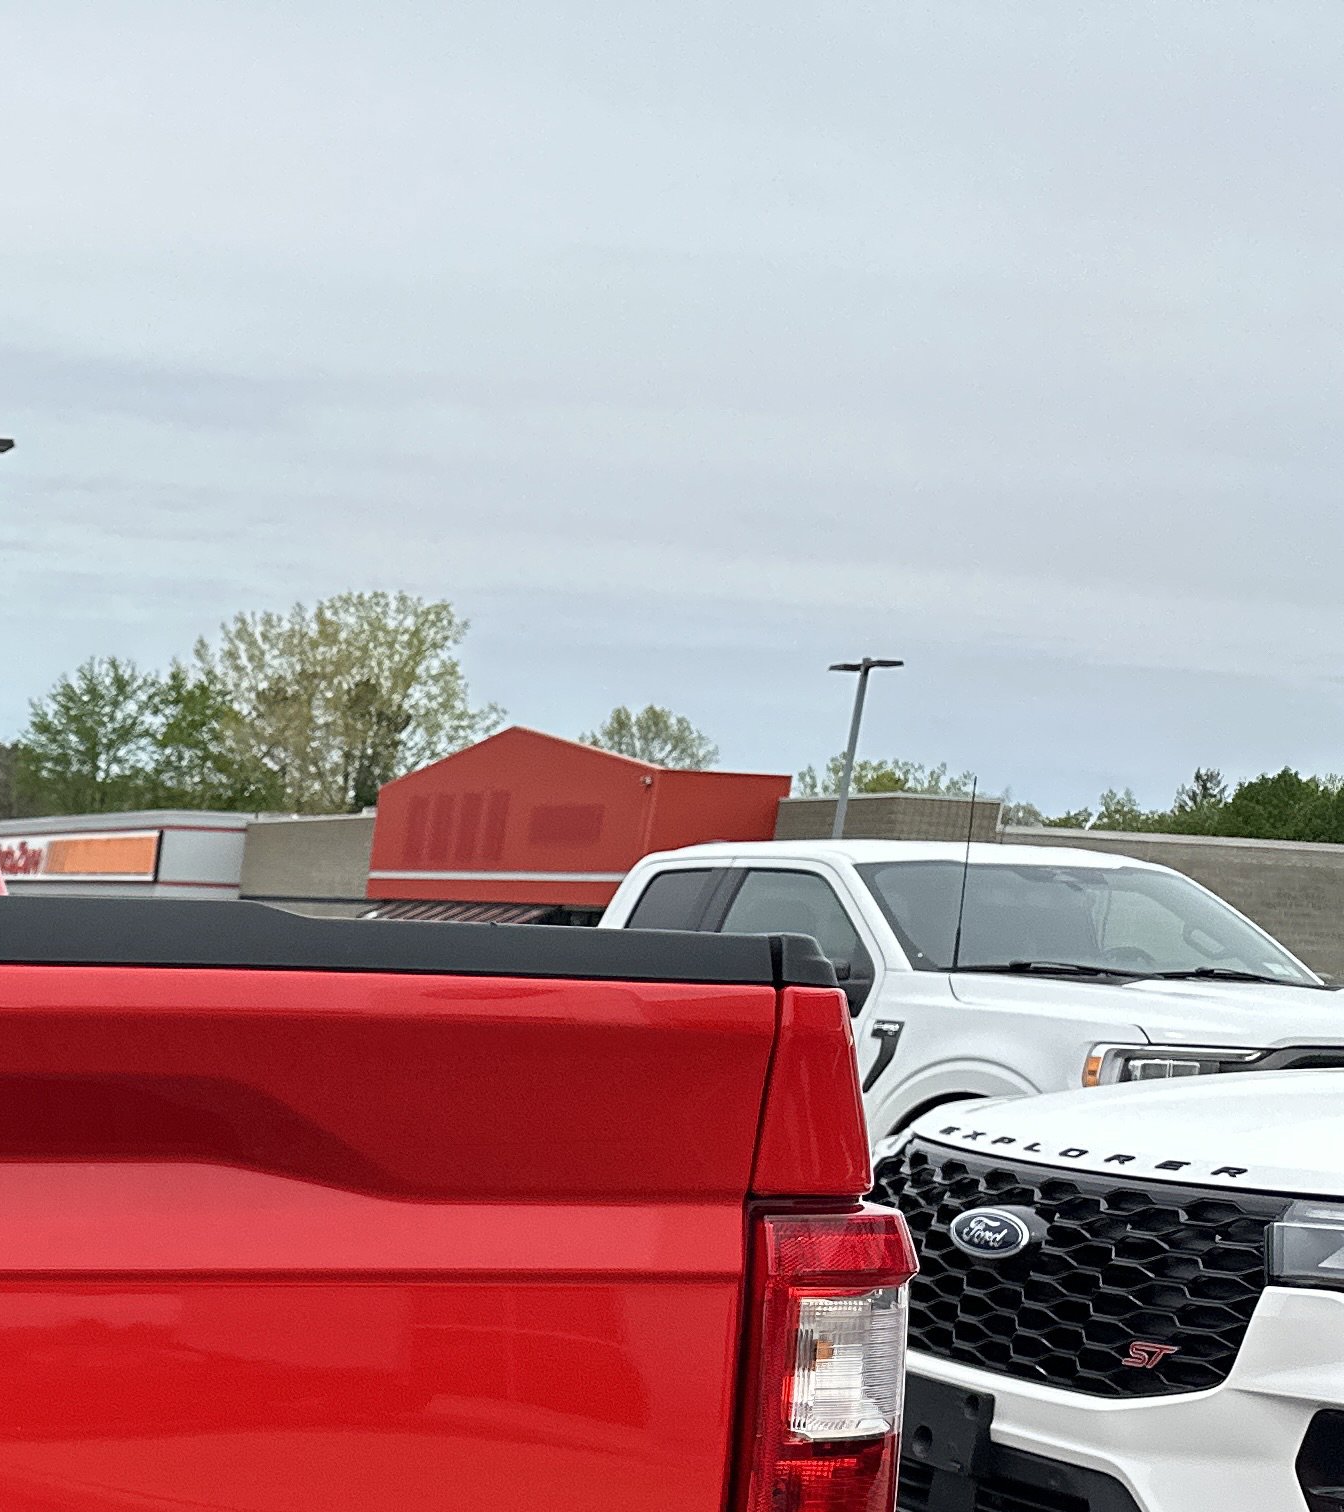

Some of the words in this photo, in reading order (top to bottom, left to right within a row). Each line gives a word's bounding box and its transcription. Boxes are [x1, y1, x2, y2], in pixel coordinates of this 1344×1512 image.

[938, 1125, 1249, 1178] EXPLORER
[962, 1216, 1009, 1248] Ford
[1122, 1341, 1181, 1369] ST
